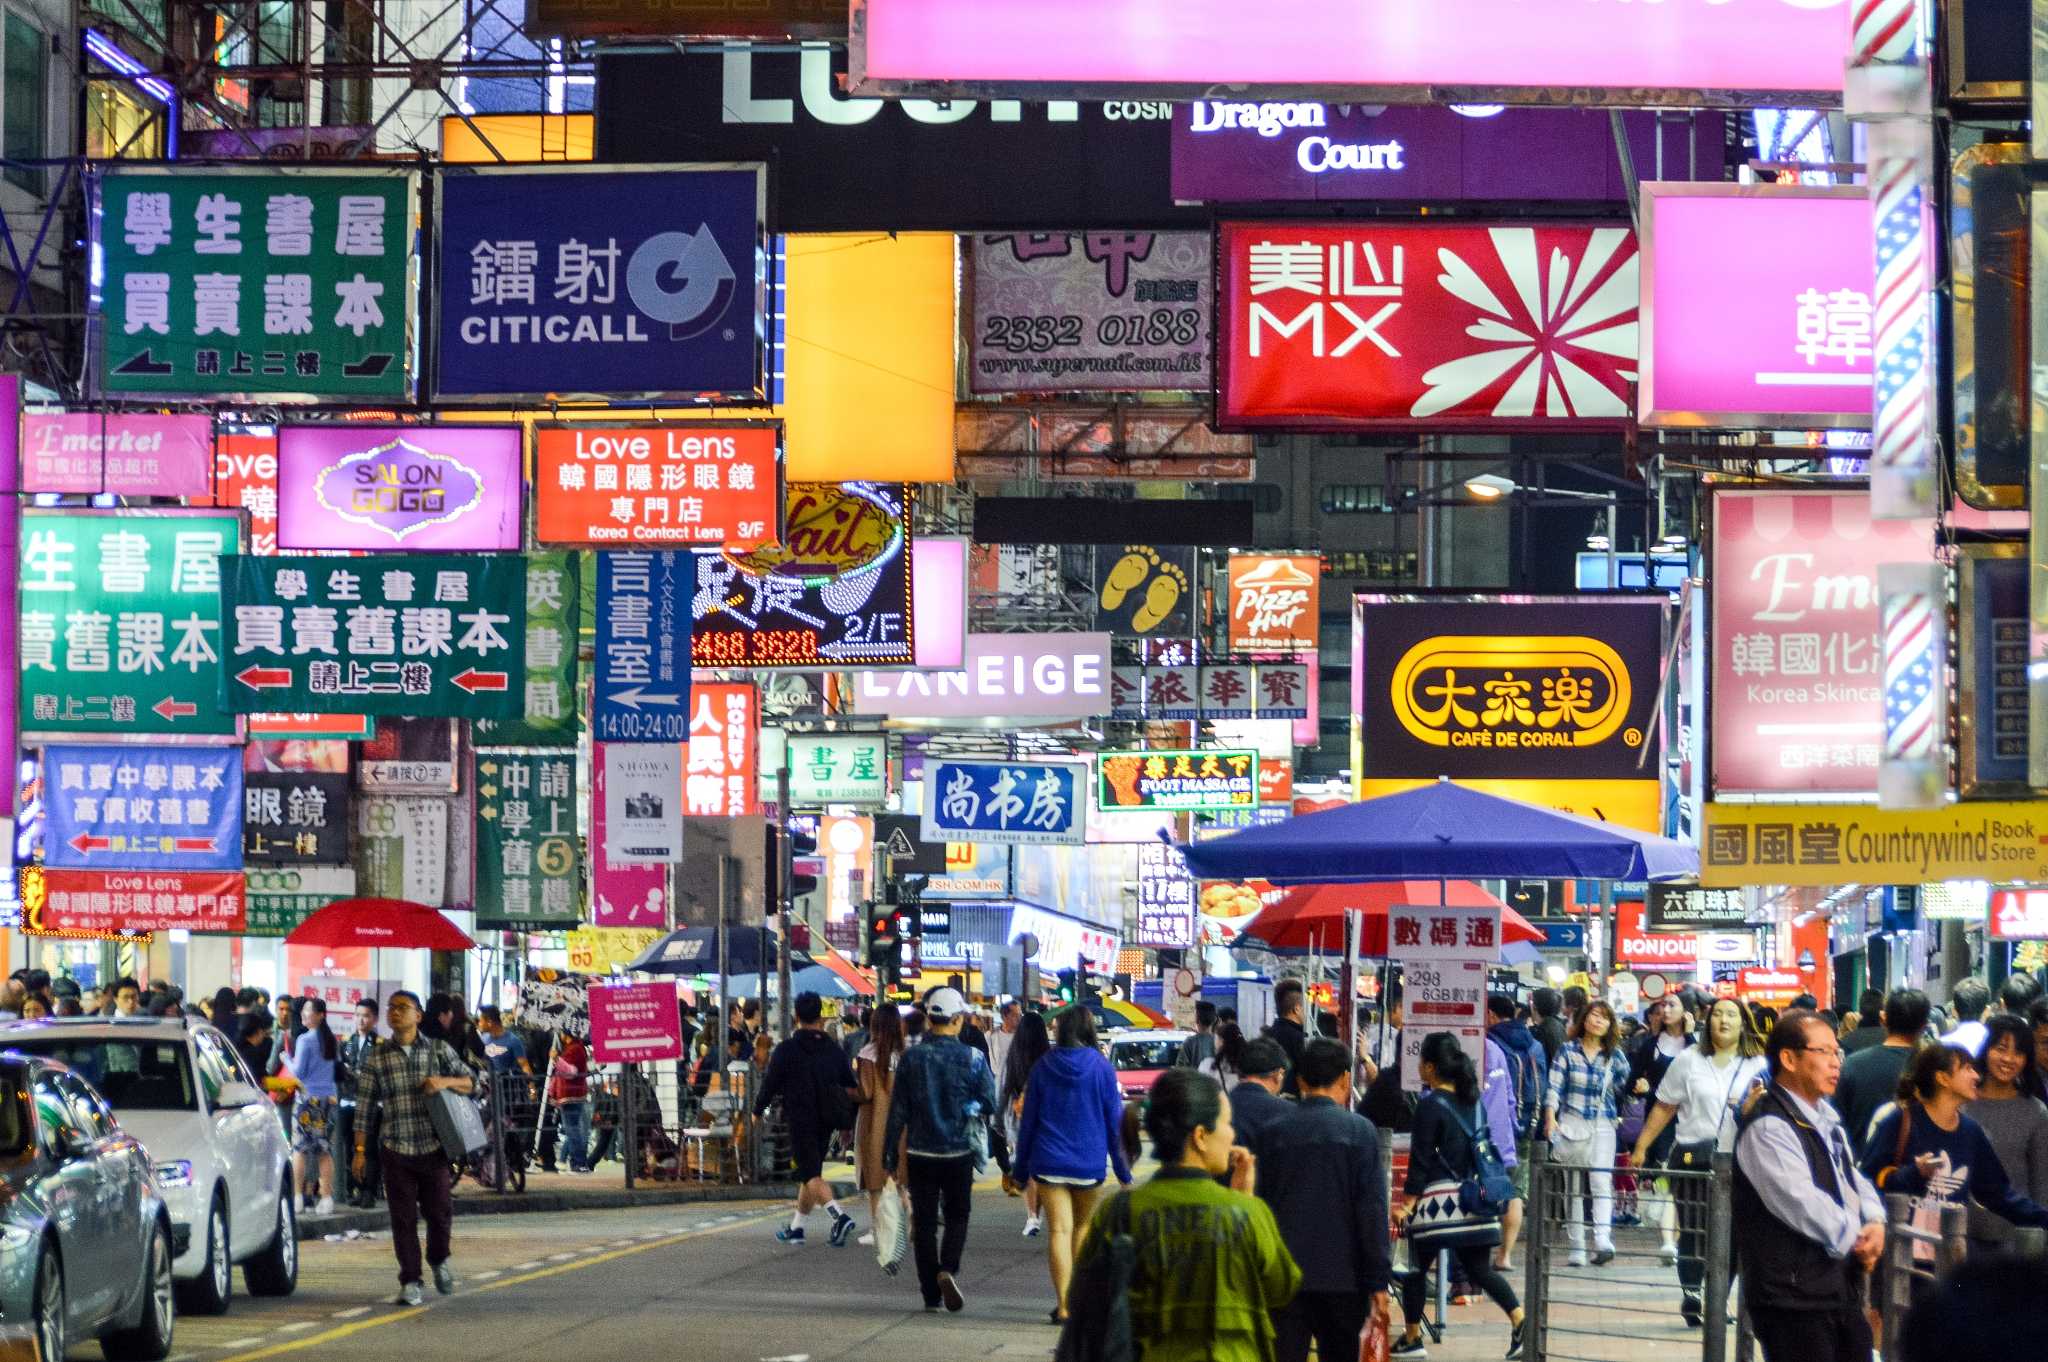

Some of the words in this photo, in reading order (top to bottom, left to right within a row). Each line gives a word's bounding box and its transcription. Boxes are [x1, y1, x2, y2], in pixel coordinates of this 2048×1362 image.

[1190, 101, 1325, 136] Dragon
[1297, 136, 1404, 173] Court
[124, 193, 385, 256] 學生書屋
[470, 238, 621, 305] 鐳射
[1250, 241, 1403, 296] 美心
[123, 273, 385, 336] 買賣課本
[460, 316, 649, 344] CITICALL
[983, 316, 1082, 352] 2332
[1098, 309, 1200, 345] 0188
[1250, 302, 1403, 357] MX
[576, 432, 650, 459] Love
[667, 432, 736, 459] Lens
[208, 453, 277, 479] ove
[355, 464, 443, 485] SALON
[558, 463, 755, 491] 韓國隱形眼鏡
[351, 488, 444, 513] GOGO
[609, 496, 703, 524] 專門店
[589, 525, 628, 539] Korea
[633, 525, 689, 539] Contact
[694, 525, 725, 539] Lens
[737, 521, 765, 538] 3/F
[275, 568, 468, 602] 學生書屋
[1235, 585, 1310, 620] Pizza
[234, 604, 510, 657] 買賣舊課本
[845, 613, 901, 643] 2/F
[1747, 684, 1808, 704] Korea
[601, 713, 685, 739] 14:00-24:00
[1495, 731, 1518, 747] DE
[1519, 731, 1574, 747] CORAL
[246, 786, 327, 827] 眼鏡
[1992, 819, 2035, 839] Book
[243, 832, 318, 856] 上一樓
[1845, 818, 1988, 874] Countrywind
[1991, 842, 2037, 861] Store
[104, 875, 142, 890] Love
[146, 876, 182, 892] Lens
[1393, 916, 1494, 947] 數碼通
